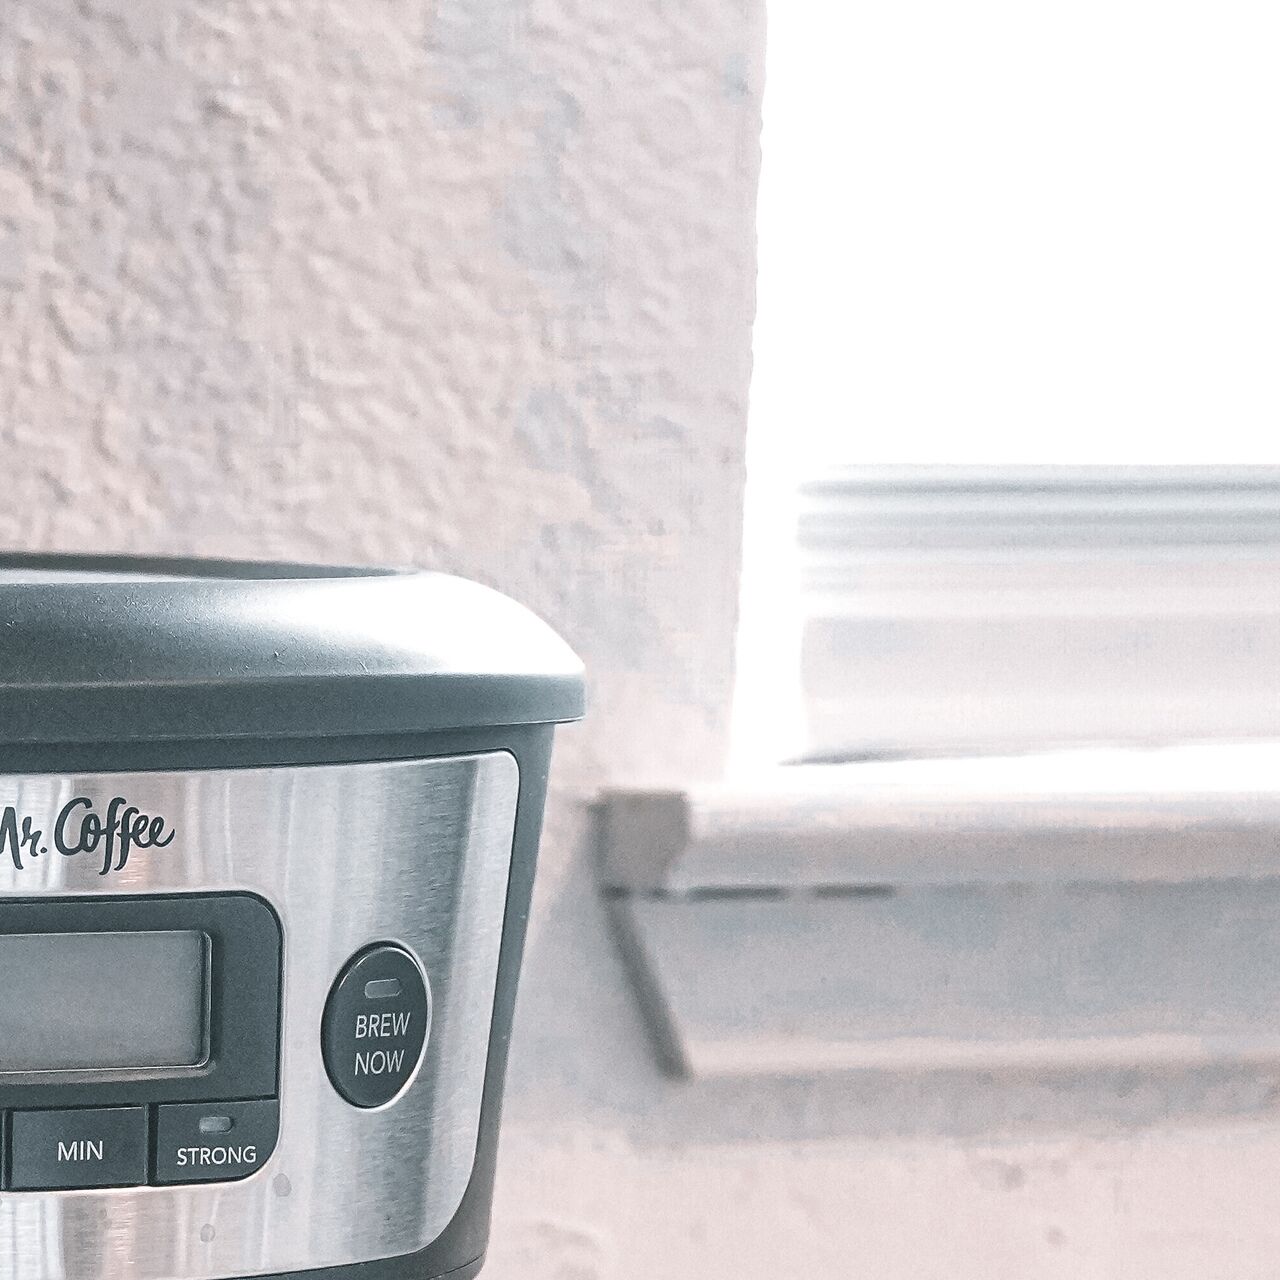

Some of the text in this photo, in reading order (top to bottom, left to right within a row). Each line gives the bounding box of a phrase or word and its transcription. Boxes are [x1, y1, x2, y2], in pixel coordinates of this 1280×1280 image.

[53, 796, 176, 876] Coffee
[354, 1011, 411, 1039] BREW
[354, 1048, 405, 1077] NOW
[56, 1140, 104, 1163] MIN
[176, 1145, 258, 1167] STRONG
